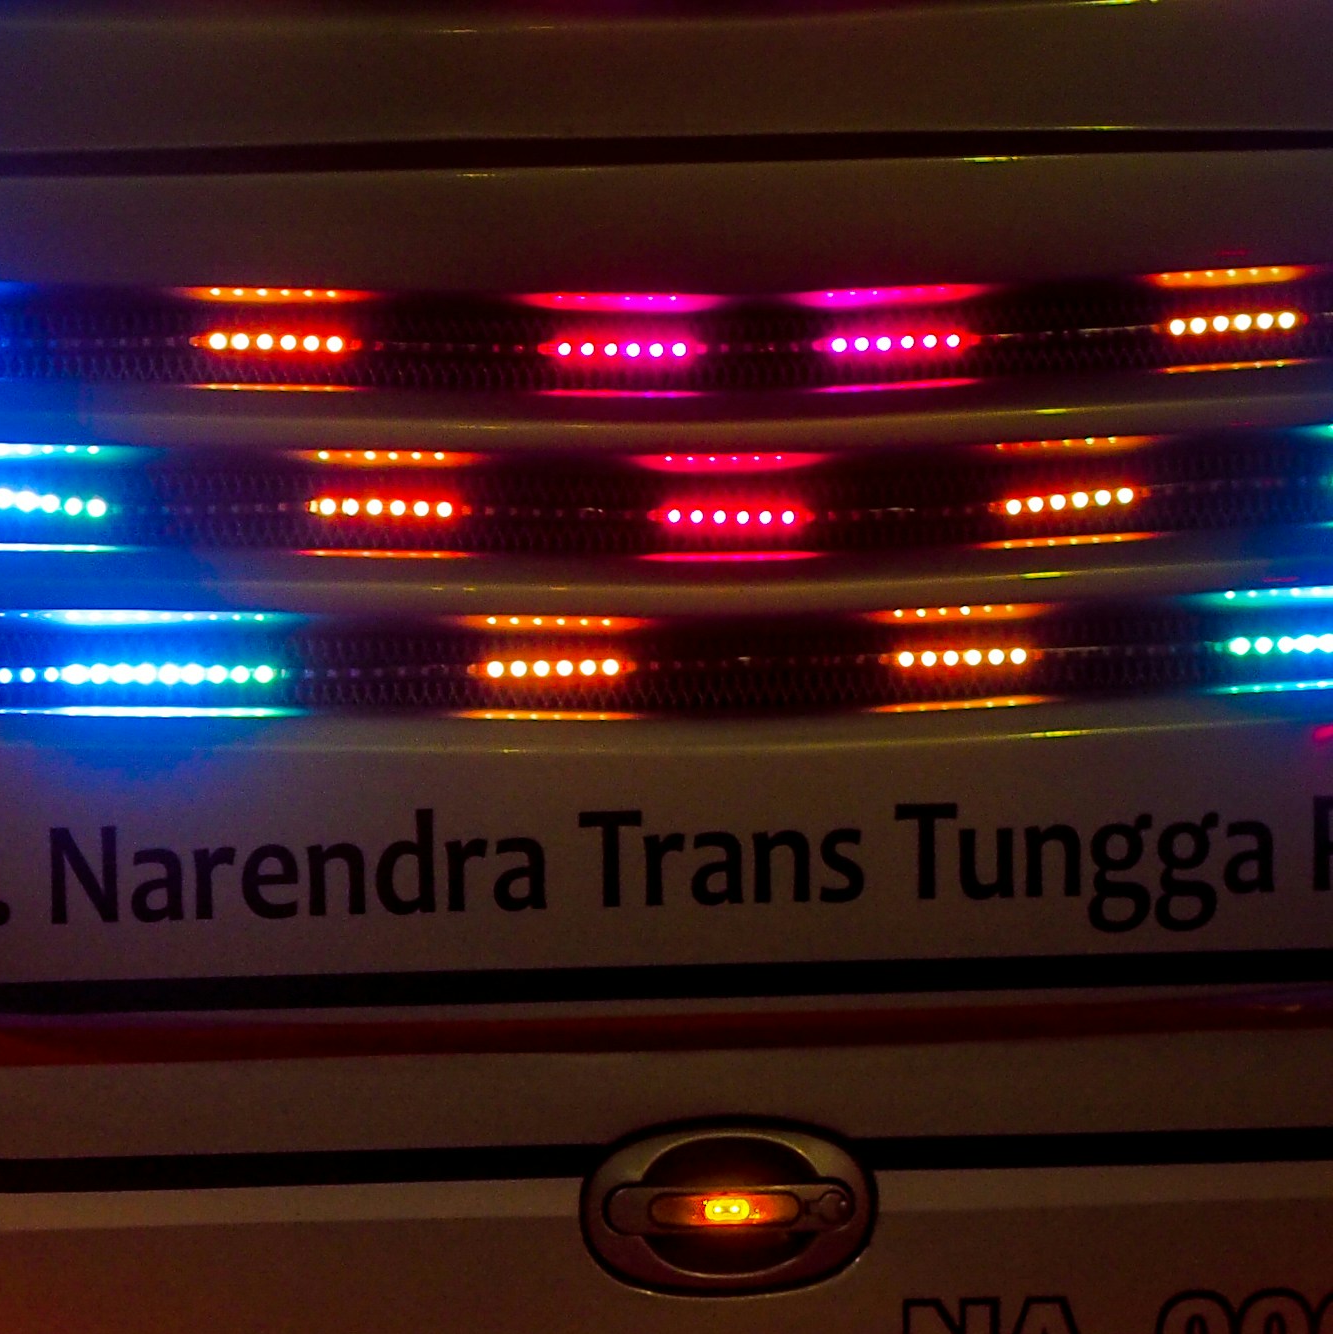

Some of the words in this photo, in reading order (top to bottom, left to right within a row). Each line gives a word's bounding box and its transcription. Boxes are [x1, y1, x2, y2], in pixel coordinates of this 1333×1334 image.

[47, 808, 547, 925] Narendra
[578, 810, 865, 908] Trans
[895, 802, 1276, 934] Tungga
